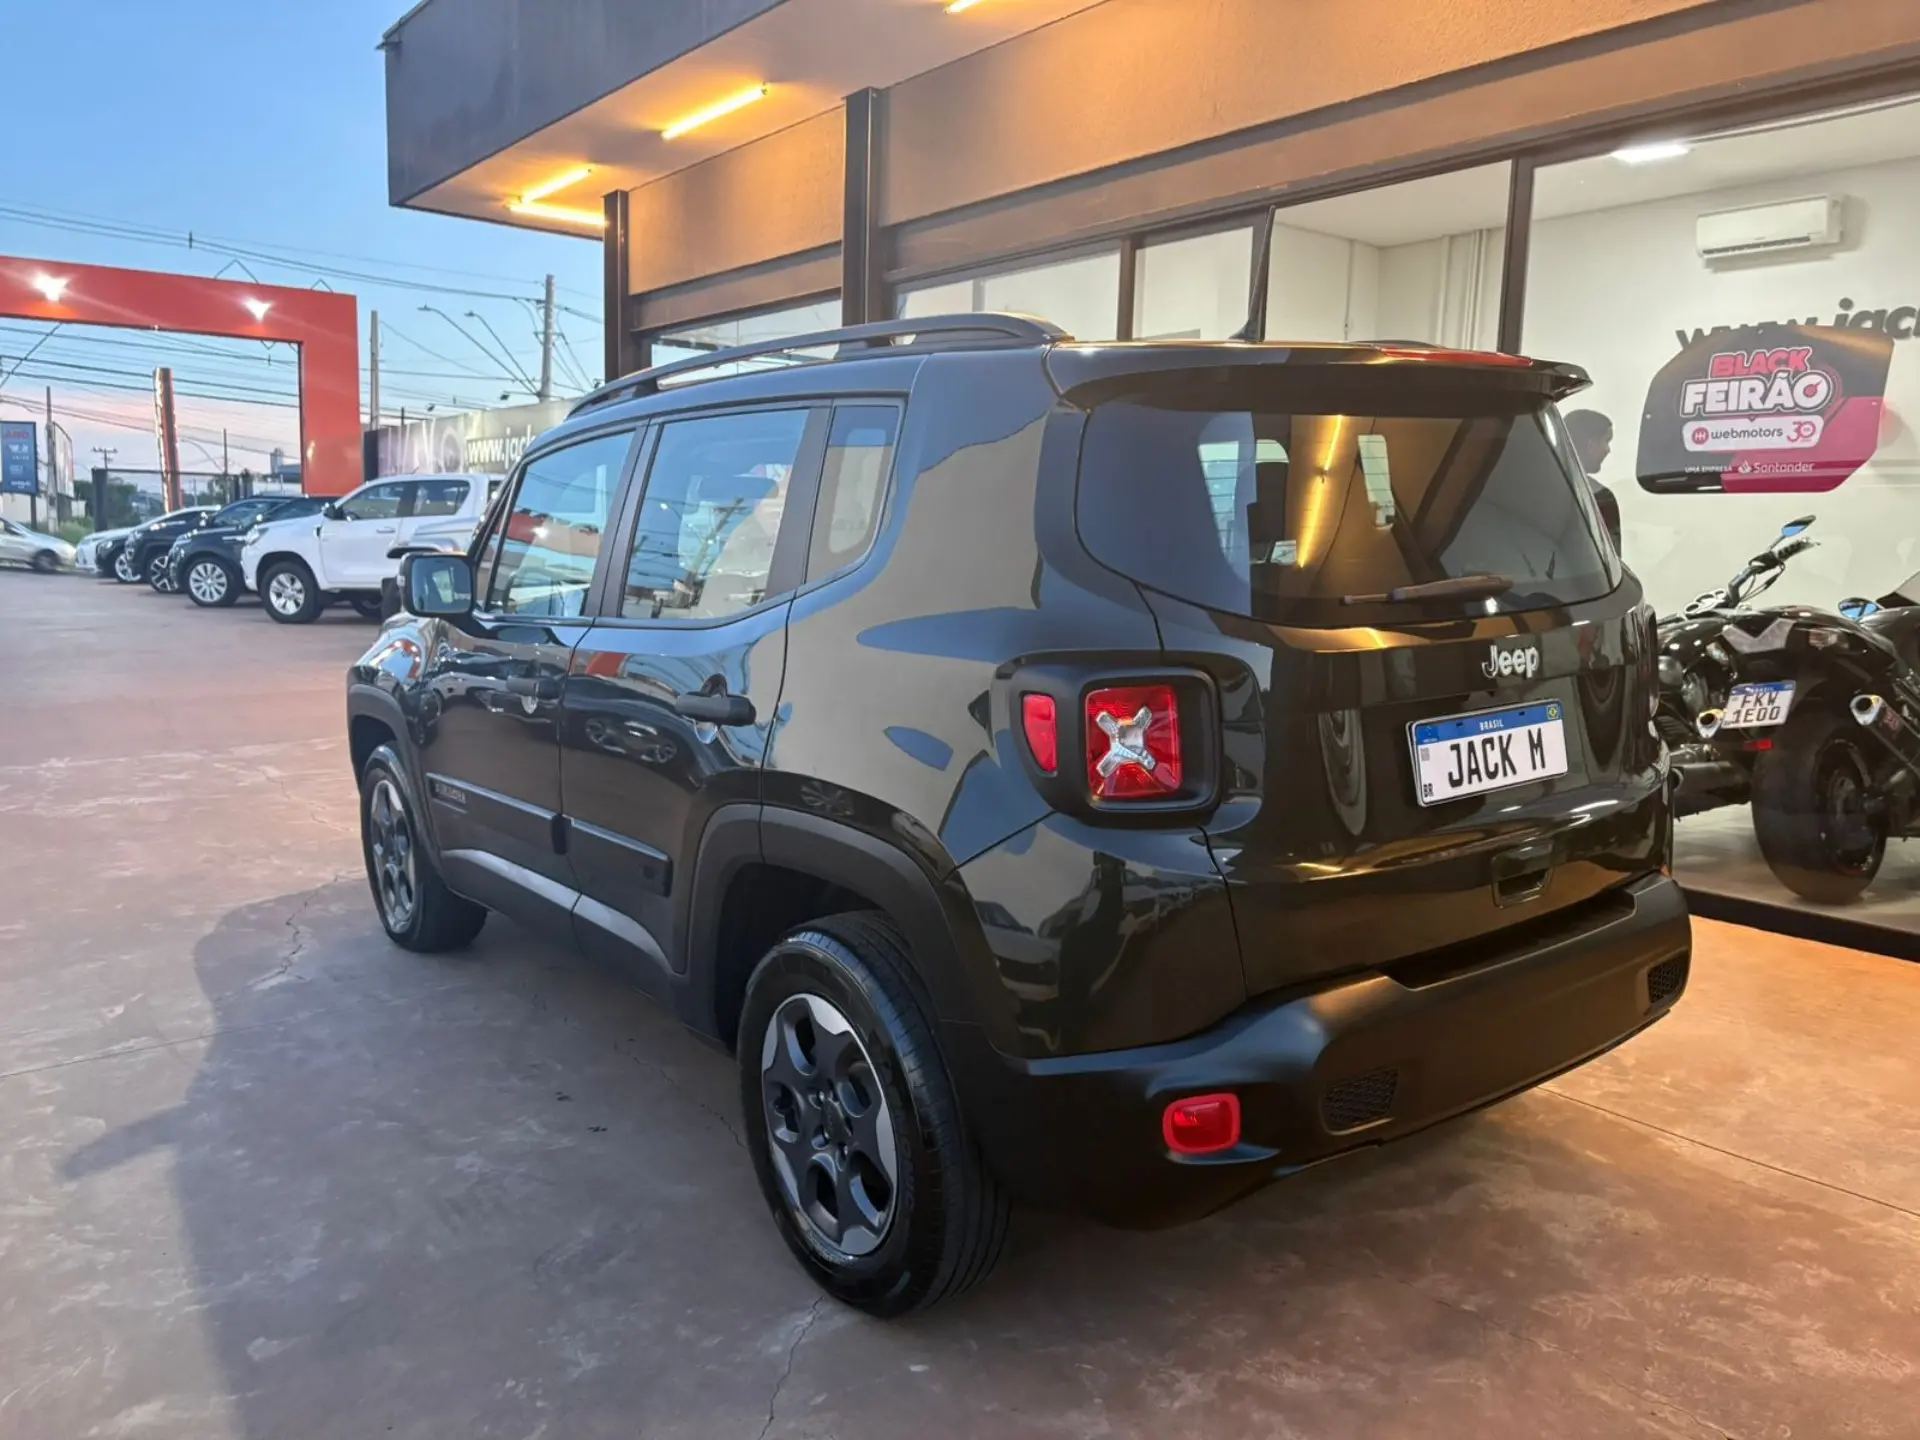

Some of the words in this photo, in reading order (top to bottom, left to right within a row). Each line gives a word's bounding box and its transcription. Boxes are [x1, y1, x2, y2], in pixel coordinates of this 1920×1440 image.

[1711, 349, 1810, 377] BLACK
[1682, 371, 1830, 415] FEIRÃO
[1711, 428, 1784, 440] webmotors
[1787, 421, 1816, 442] 30
[1753, 462, 1815, 474] Santander
[1481, 645, 1540, 678] Jeep
[1479, 719, 1504, 732] BRASIL
[1448, 733, 1517, 788] JACK
[1528, 727, 1546, 771] M
[1423, 783, 1434, 798] BR
